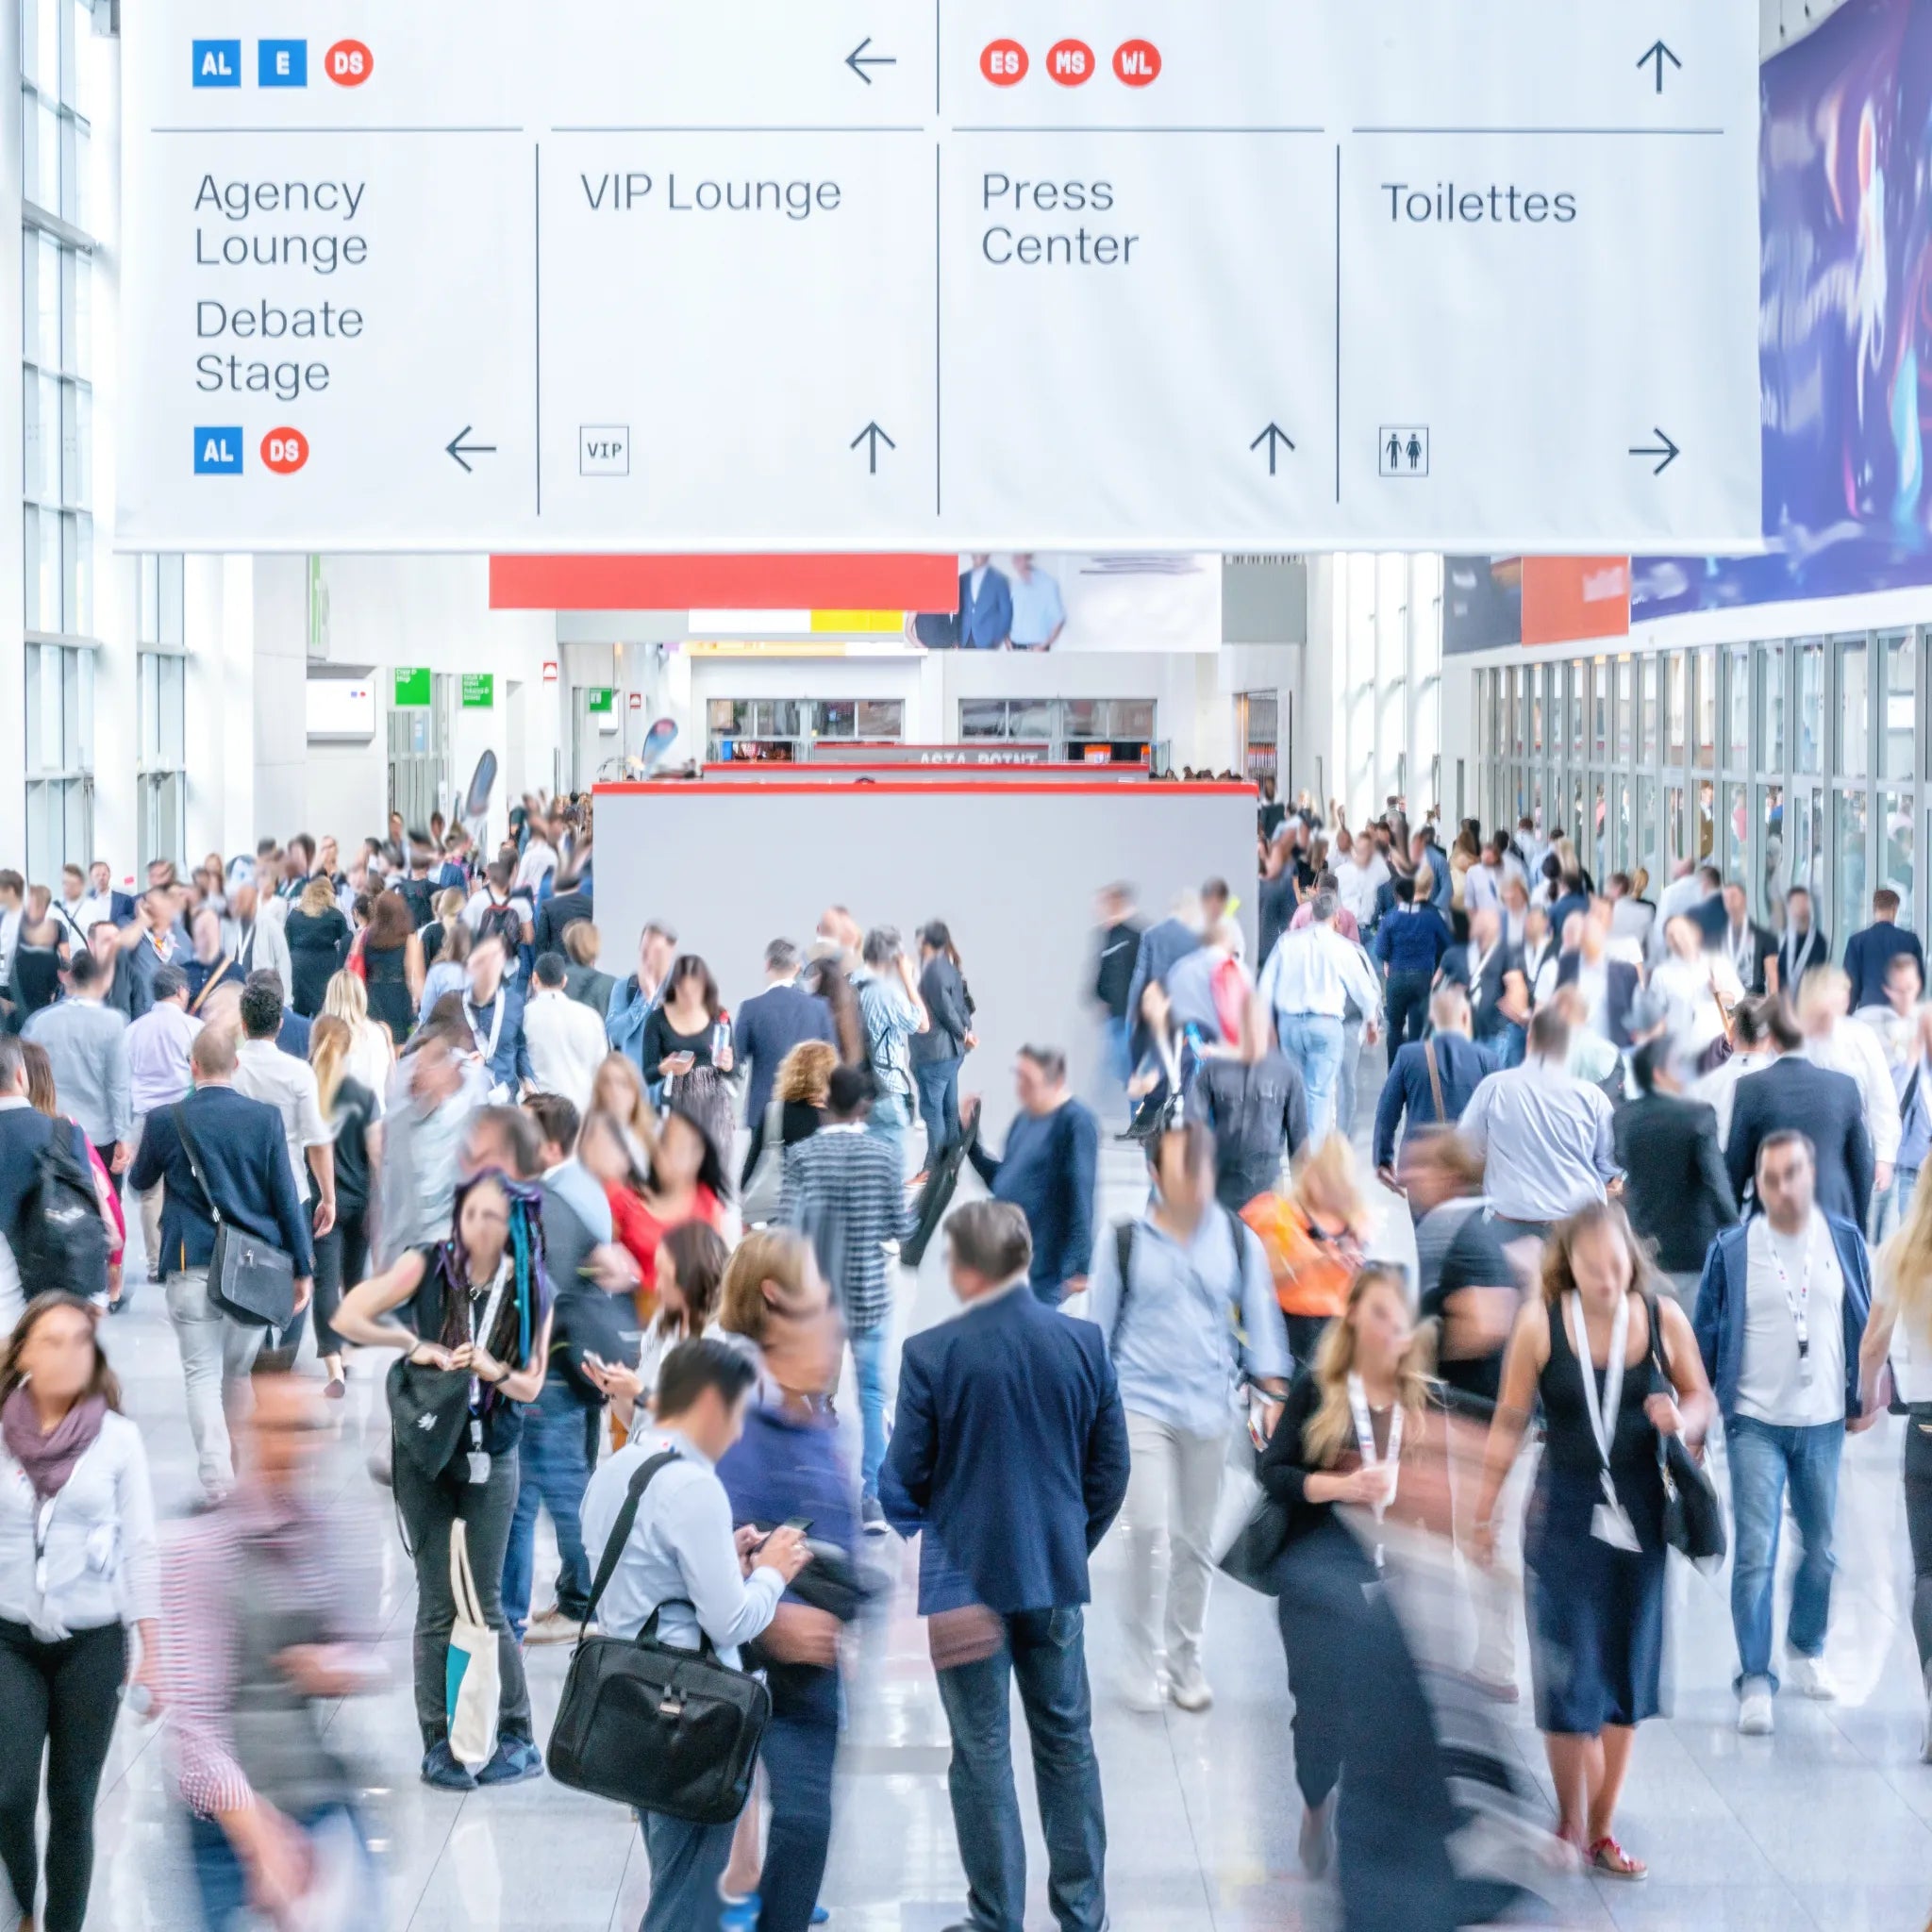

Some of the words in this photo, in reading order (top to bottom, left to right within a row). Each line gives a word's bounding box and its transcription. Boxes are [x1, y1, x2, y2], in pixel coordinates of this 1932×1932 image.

[201, 51, 232, 75] AL
[275, 51, 290, 75] E
[334, 51, 364, 75] DS
[990, 51, 1020, 75] ES
[1055, 51, 1086, 75] MS
[1121, 51, 1153, 75] WL
[194, 175, 366, 221] Agency
[580, 174, 653, 209] VIP
[669, 174, 841, 220] Lounge
[983, 174, 1114, 211] Press
[1380, 182, 1577, 223] Toilettes
[196, 228, 368, 275] Lounge
[982, 226, 1140, 265] Center
[196, 298, 363, 338] Debate
[195, 354, 330, 401] Stage
[203, 439, 234, 462] AL
[269, 439, 299, 462] DS
[588, 442, 622, 458] VIP
